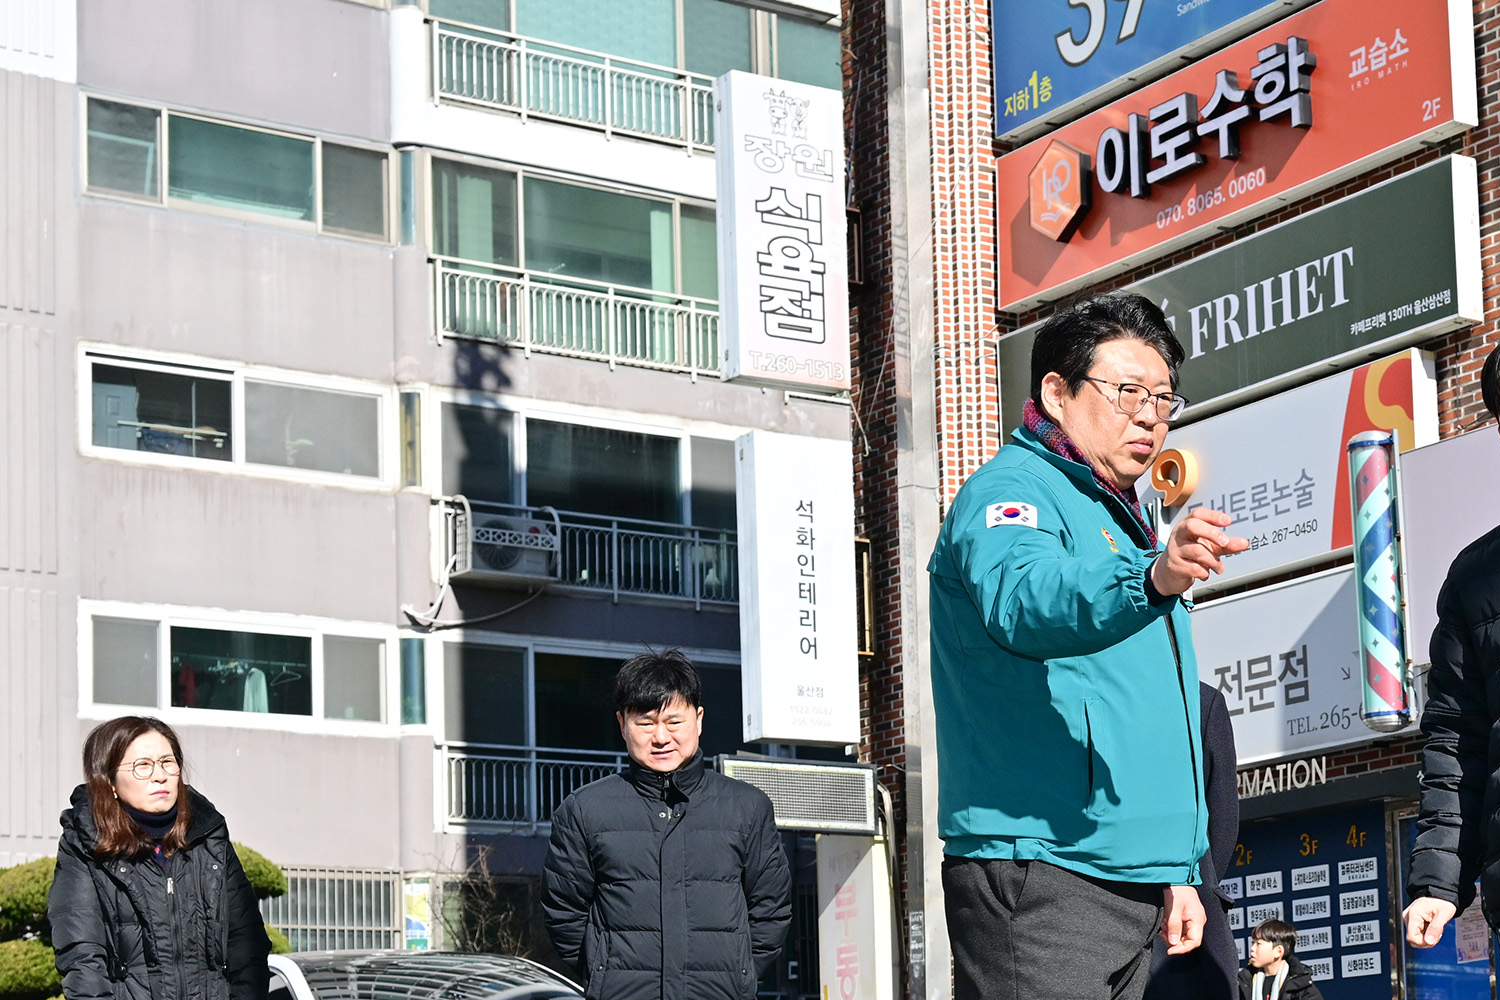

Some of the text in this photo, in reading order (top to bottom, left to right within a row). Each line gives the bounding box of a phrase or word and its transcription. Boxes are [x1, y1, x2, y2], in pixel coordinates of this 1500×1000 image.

[1348, 27, 1410, 79] 교습소
[1377, 59, 1409, 79] MATH
[1003, 69, 1053, 117] 지하1층
[1421, 97, 1441, 122] 2F
[1095, 35, 1318, 199] 이로수학
[744, 134, 834, 183] 장원
[754, 186, 827, 345] 식육점
[1187, 247, 1354, 361] FRIHET
[1413, 288, 1452, 316] 울산삼산점
[748, 350, 845, 382] T.260-1513
[1188, 467, 1316, 532] 서토론논술
[1271, 519, 1318, 544] 267-0450
[795, 499, 818, 661] 석화인테리어
[796, 684, 825, 699] 울산점
[1214, 644, 1310, 718] 전문점
[1235, 843, 1253, 867] 2F
[1299, 833, 1319, 856] 3F
[1346, 824, 1367, 848] 4F
